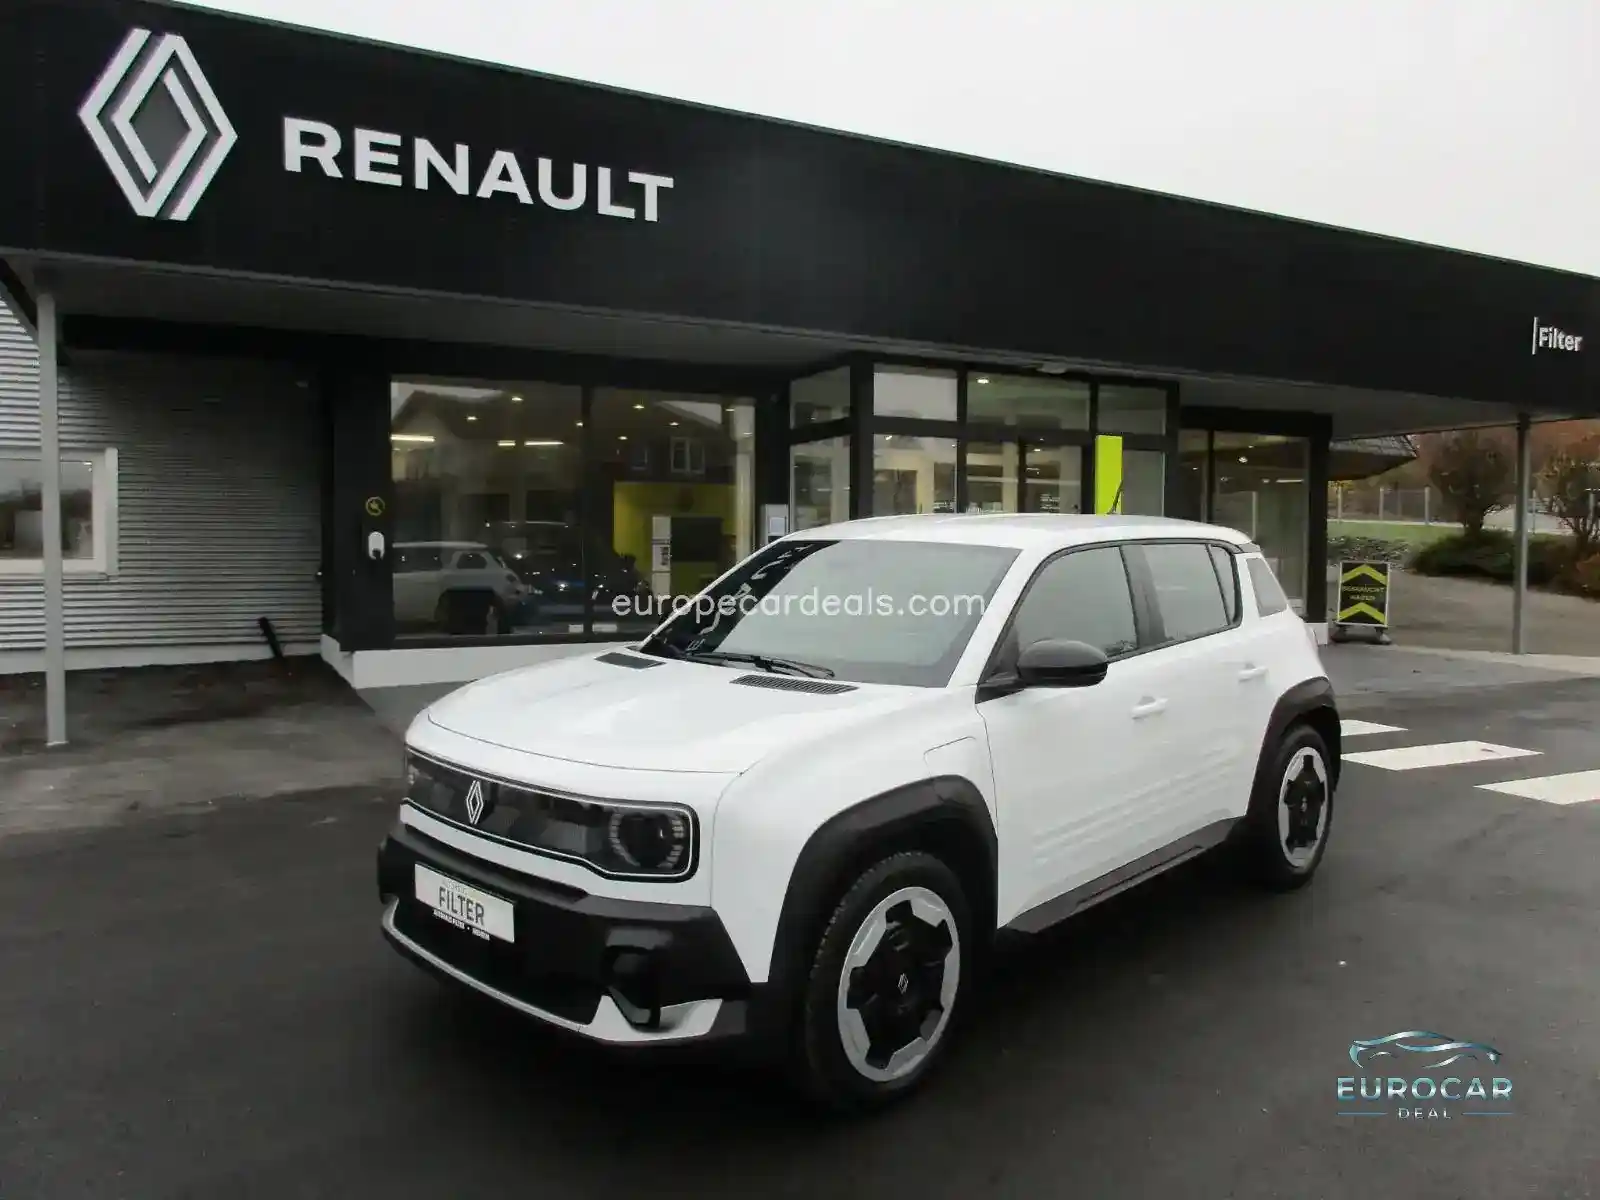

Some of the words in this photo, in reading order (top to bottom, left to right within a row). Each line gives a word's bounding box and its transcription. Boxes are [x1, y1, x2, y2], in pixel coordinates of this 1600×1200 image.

[284, 116, 674, 222] RENAULT
[1539, 326, 1583, 351] Filter
[439, 886, 484, 926] FILTER
